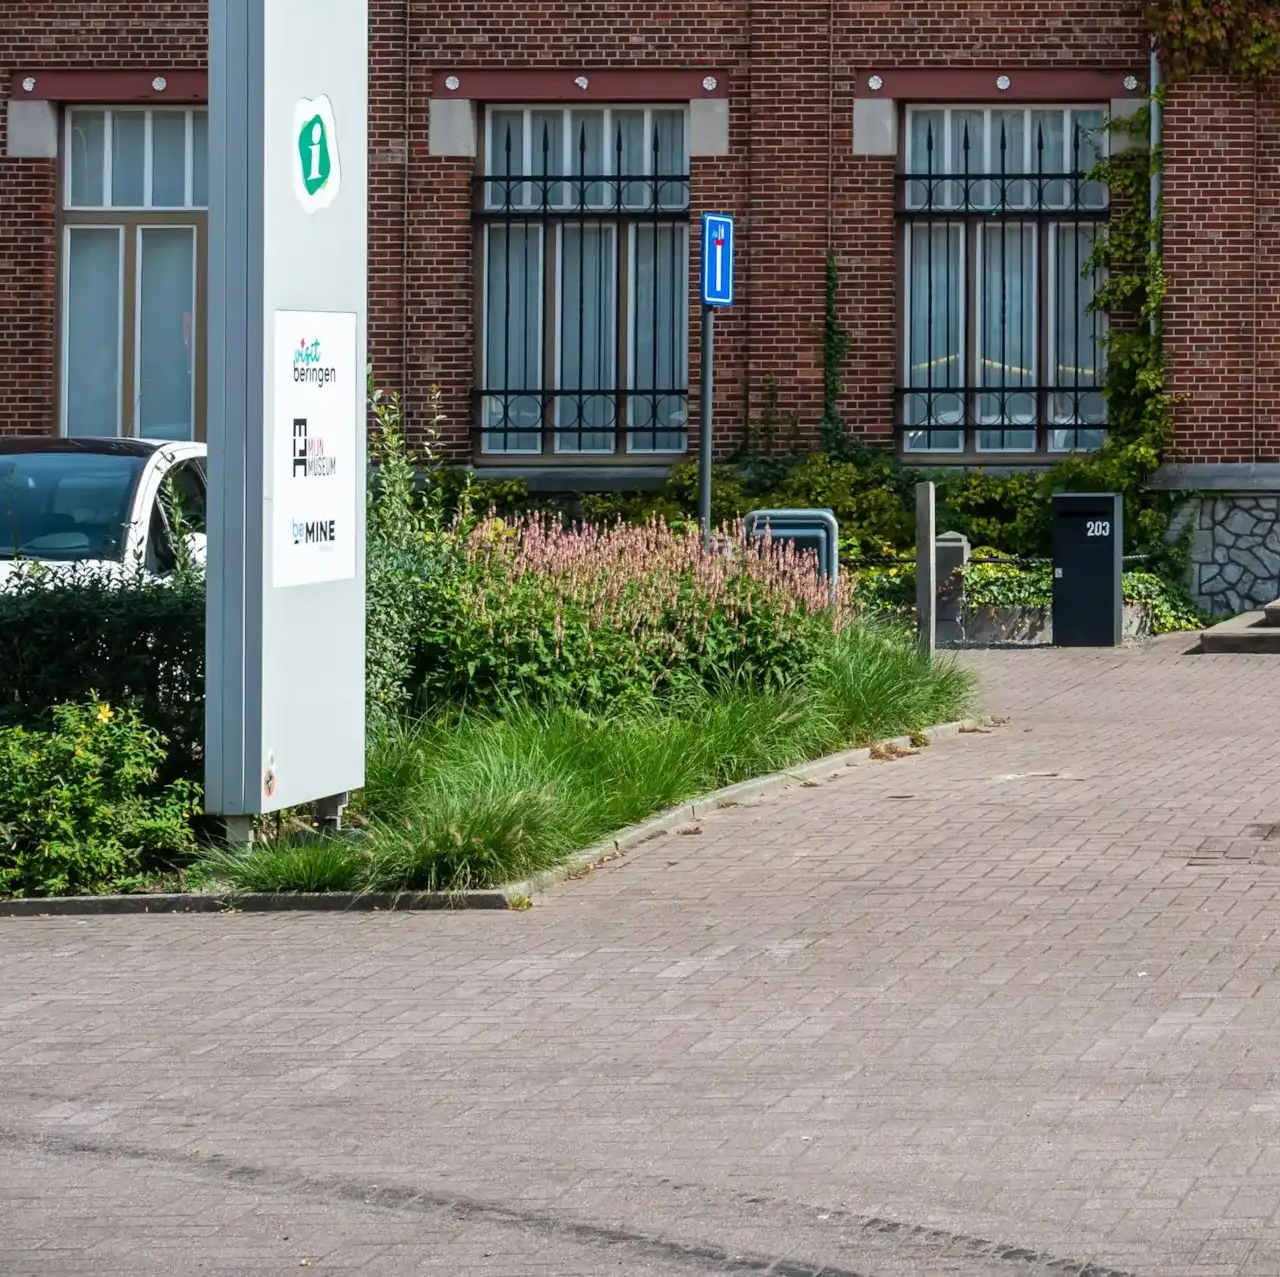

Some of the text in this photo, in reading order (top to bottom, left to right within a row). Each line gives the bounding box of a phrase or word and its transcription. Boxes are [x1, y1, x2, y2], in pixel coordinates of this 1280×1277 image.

[294, 338, 322, 366] visit
[293, 359, 337, 388] beringen
[307, 437, 324, 456] MIJN
[307, 456, 336, 476] MUSEUM
[1086, 521, 1110, 537] 203
